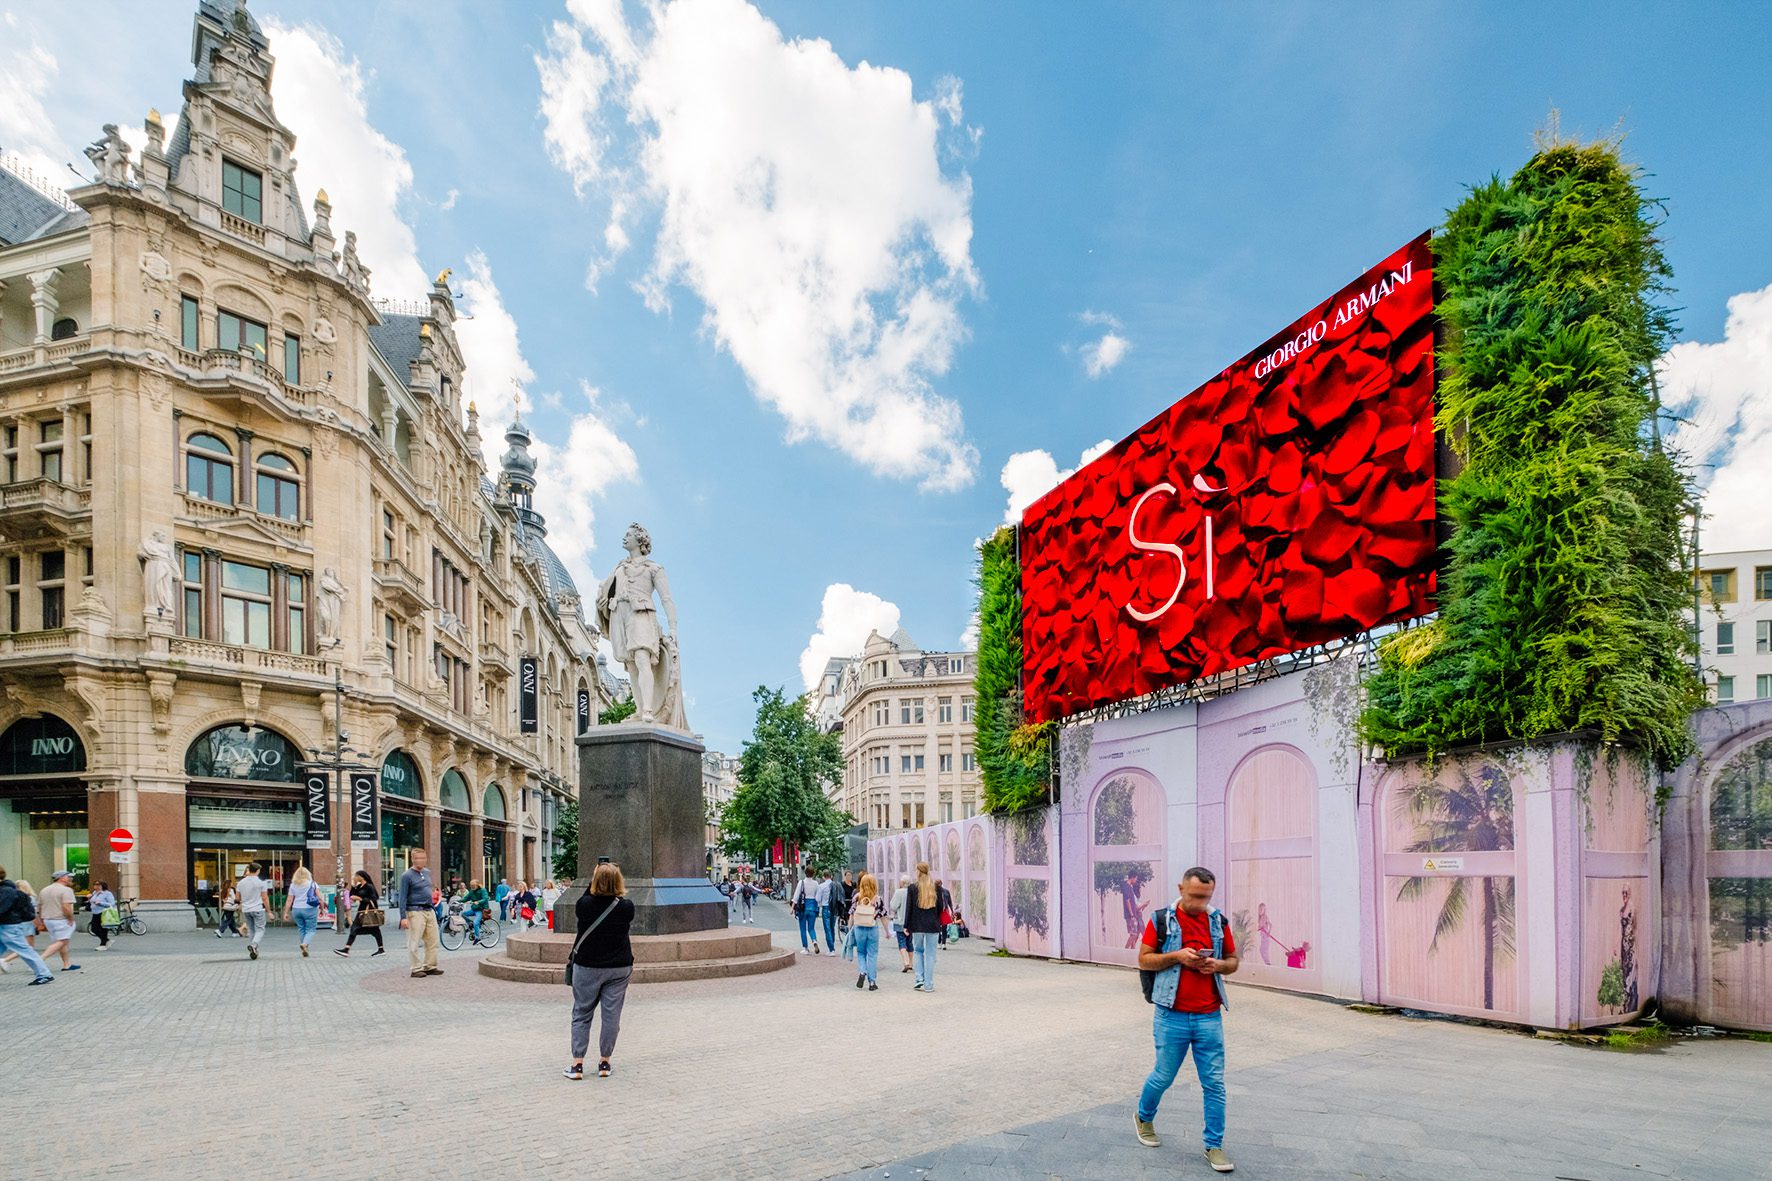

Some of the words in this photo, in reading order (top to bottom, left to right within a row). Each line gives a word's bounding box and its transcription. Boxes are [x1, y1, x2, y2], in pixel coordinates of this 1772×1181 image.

[1254, 320, 1327, 379] GIORGIO
[1333, 260, 1413, 331] ARMANI
[523, 663, 534, 695] INNO
[579, 694, 588, 716] INNO
[31, 736, 74, 756] INNO
[215, 745, 281, 766] INNO
[383, 764, 405, 782] INNO
[308, 777, 326, 825] INNO
[355, 778, 372, 825] INNO
